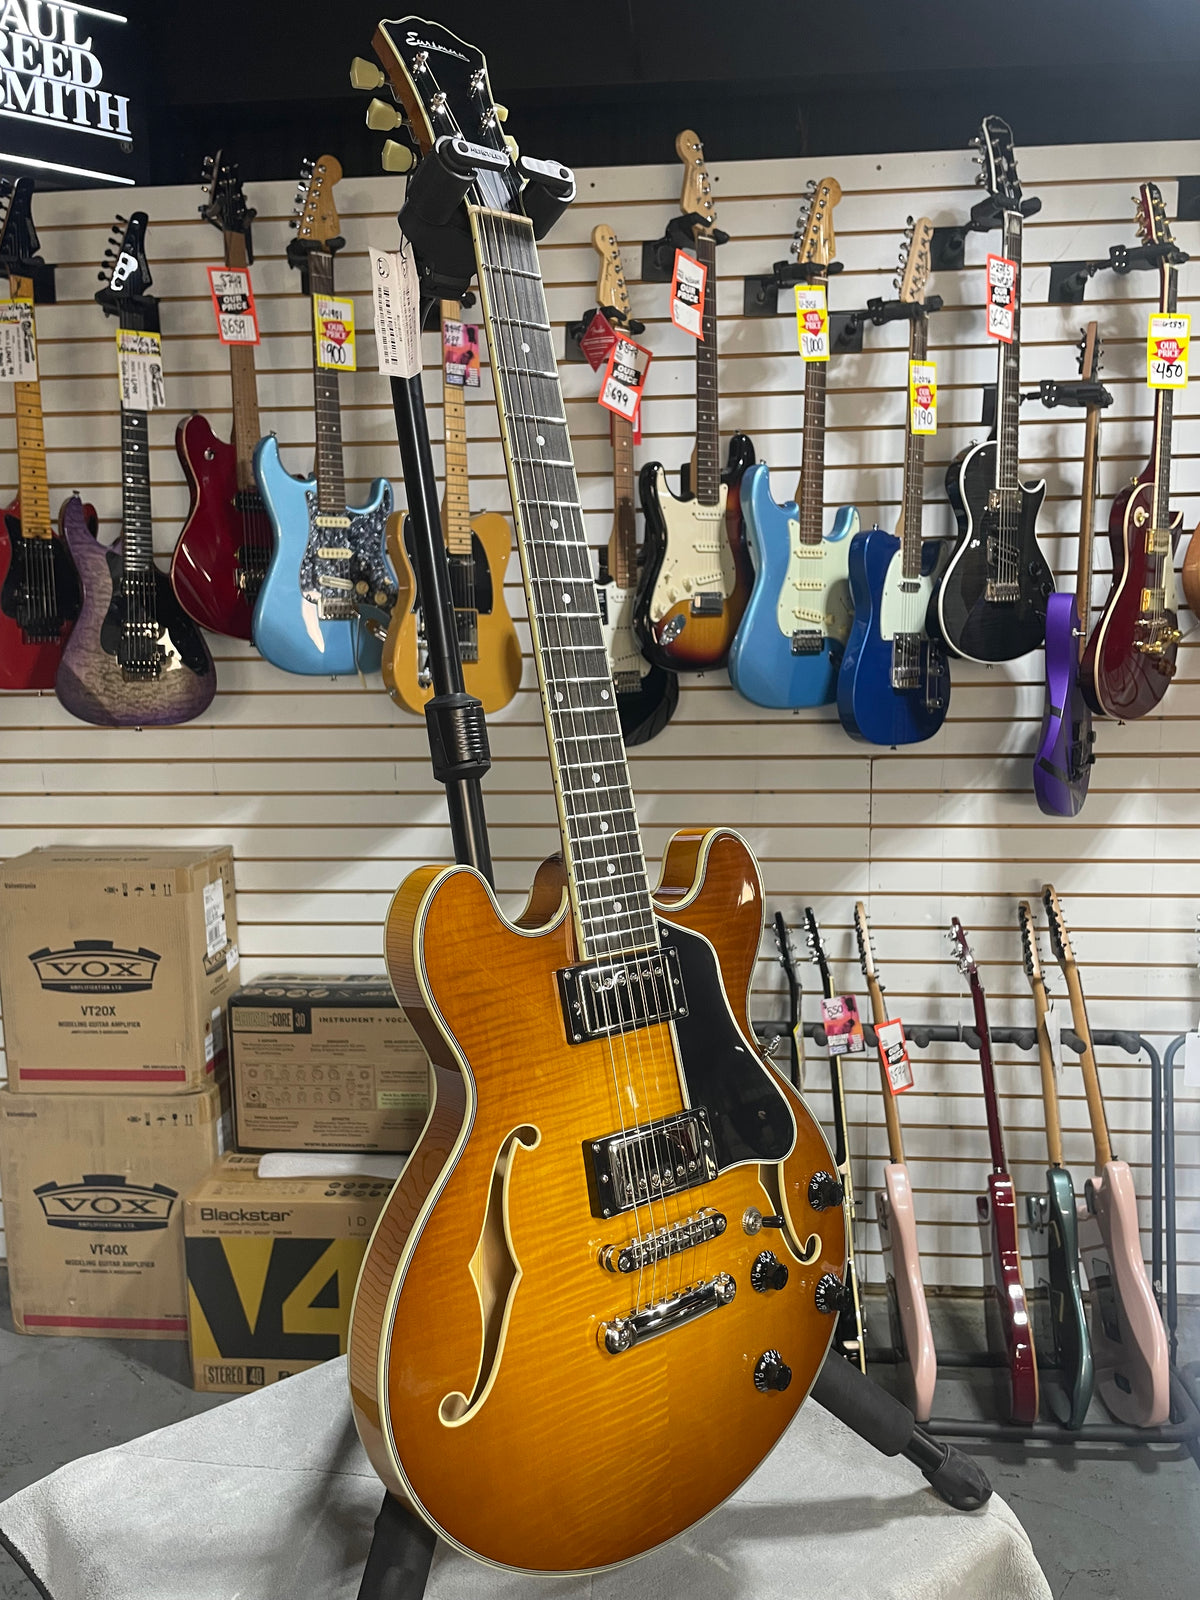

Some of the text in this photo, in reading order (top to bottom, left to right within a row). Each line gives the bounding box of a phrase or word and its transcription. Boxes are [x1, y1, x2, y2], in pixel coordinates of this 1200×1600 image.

[0, 0, 92, 51] AUL
[0, 67, 131, 134] MITH
[221, 301, 248, 312] PRICE
[223, 296, 242, 304] OUR
[1160, 341, 1178, 349] OUR
[1157, 349, 1180, 358] PRICE
[613, 370, 639, 385] PRICE
[617, 365, 636, 377] OUR
[46, 961, 142, 977] VOX
[81, 1005, 117, 1016] VT20X
[52, 1196, 157, 1214] VOX
[200, 1208, 291, 1222] Blackstar
[90, 1243, 129, 1256] VT40X
[208, 1366, 244, 1384] STEREO
